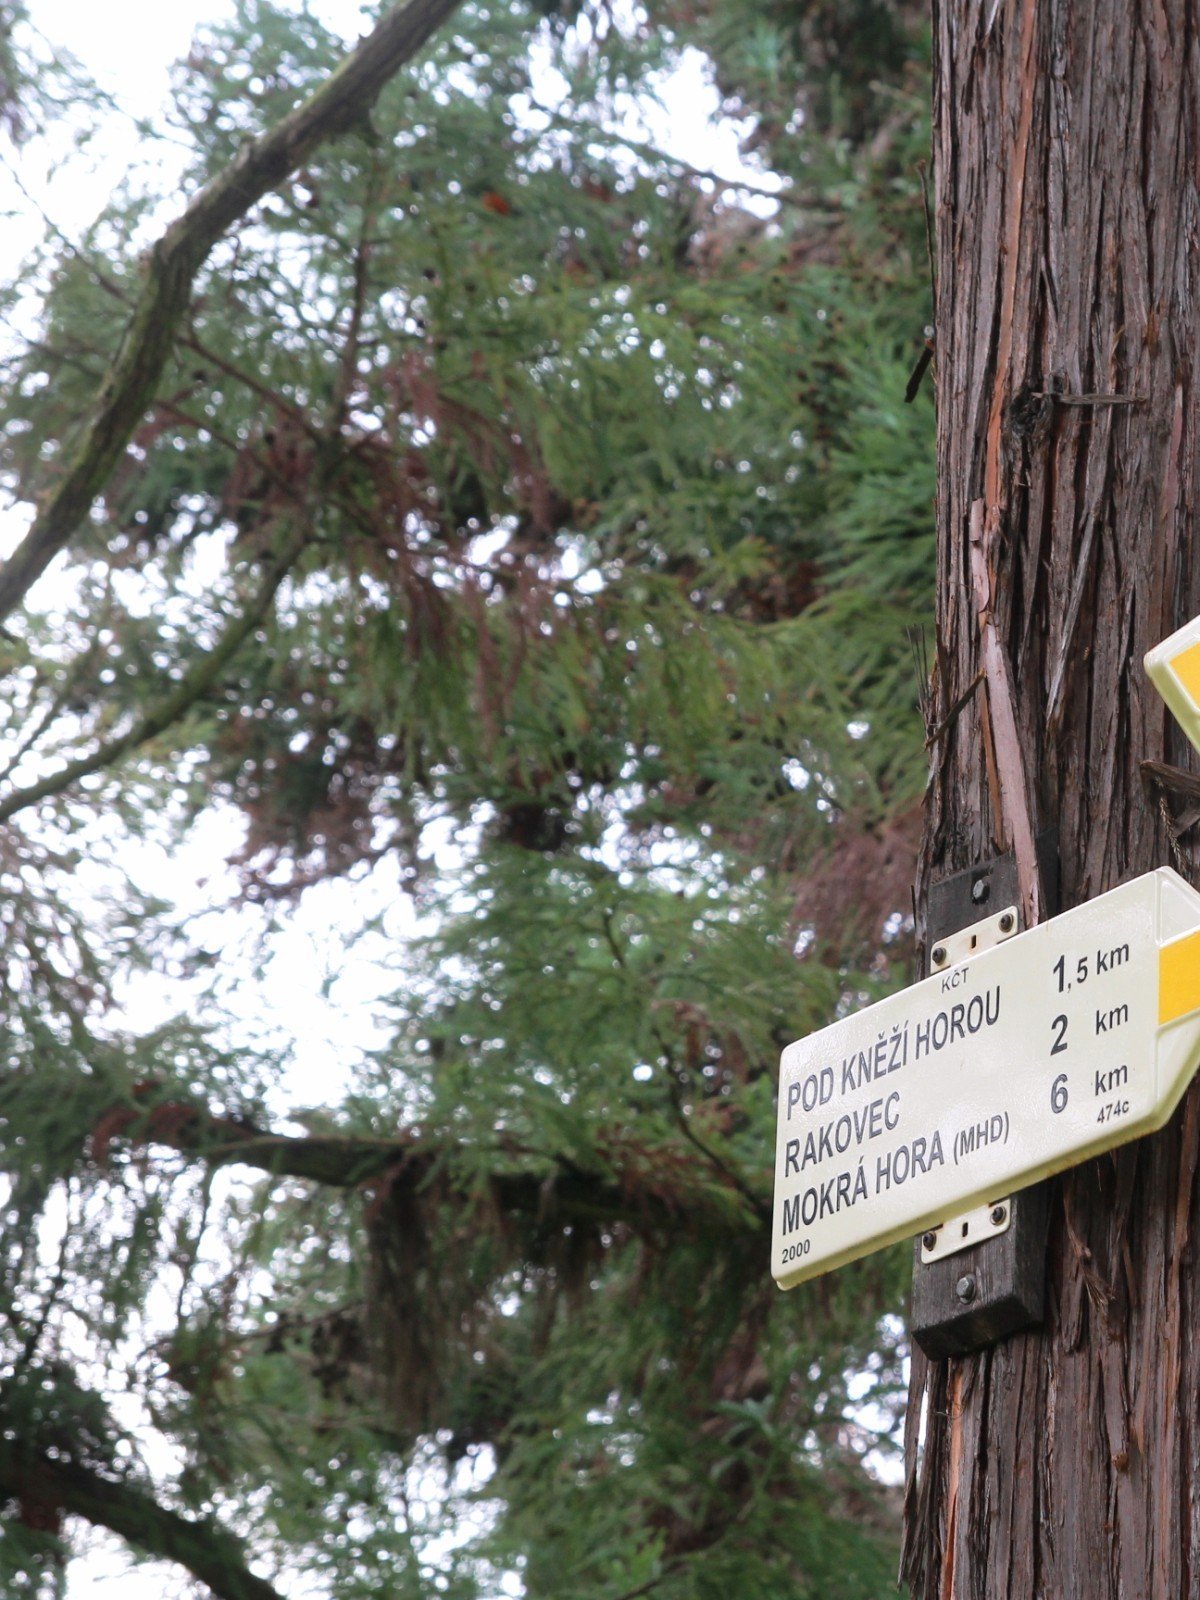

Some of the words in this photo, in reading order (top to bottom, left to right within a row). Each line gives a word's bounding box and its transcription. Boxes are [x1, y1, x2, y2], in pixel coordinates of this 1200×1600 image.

[942, 966, 970, 994] KČT
[787, 1066, 834, 1120] POD
[841, 1020, 909, 1095] KNĚŽÍ
[916, 985, 1000, 1059] HOROU
[1053, 954, 1088, 994] 1,5
[1096, 943, 1129, 975] km
[785, 1091, 900, 1177] RAKOVEC
[1050, 1014, 1068, 1056] 2
[1095, 1003, 1129, 1035] km
[1097, 1100, 1130, 1124] 474c
[782, 1156, 868, 1236] MOKRÁ
[876, 1130, 945, 1194] HORA
[953, 1111, 1010, 1165] (MHD)
[1050, 1073, 1069, 1114] 6
[1095, 1064, 1128, 1096] km
[781, 1239, 810, 1264] 2000
